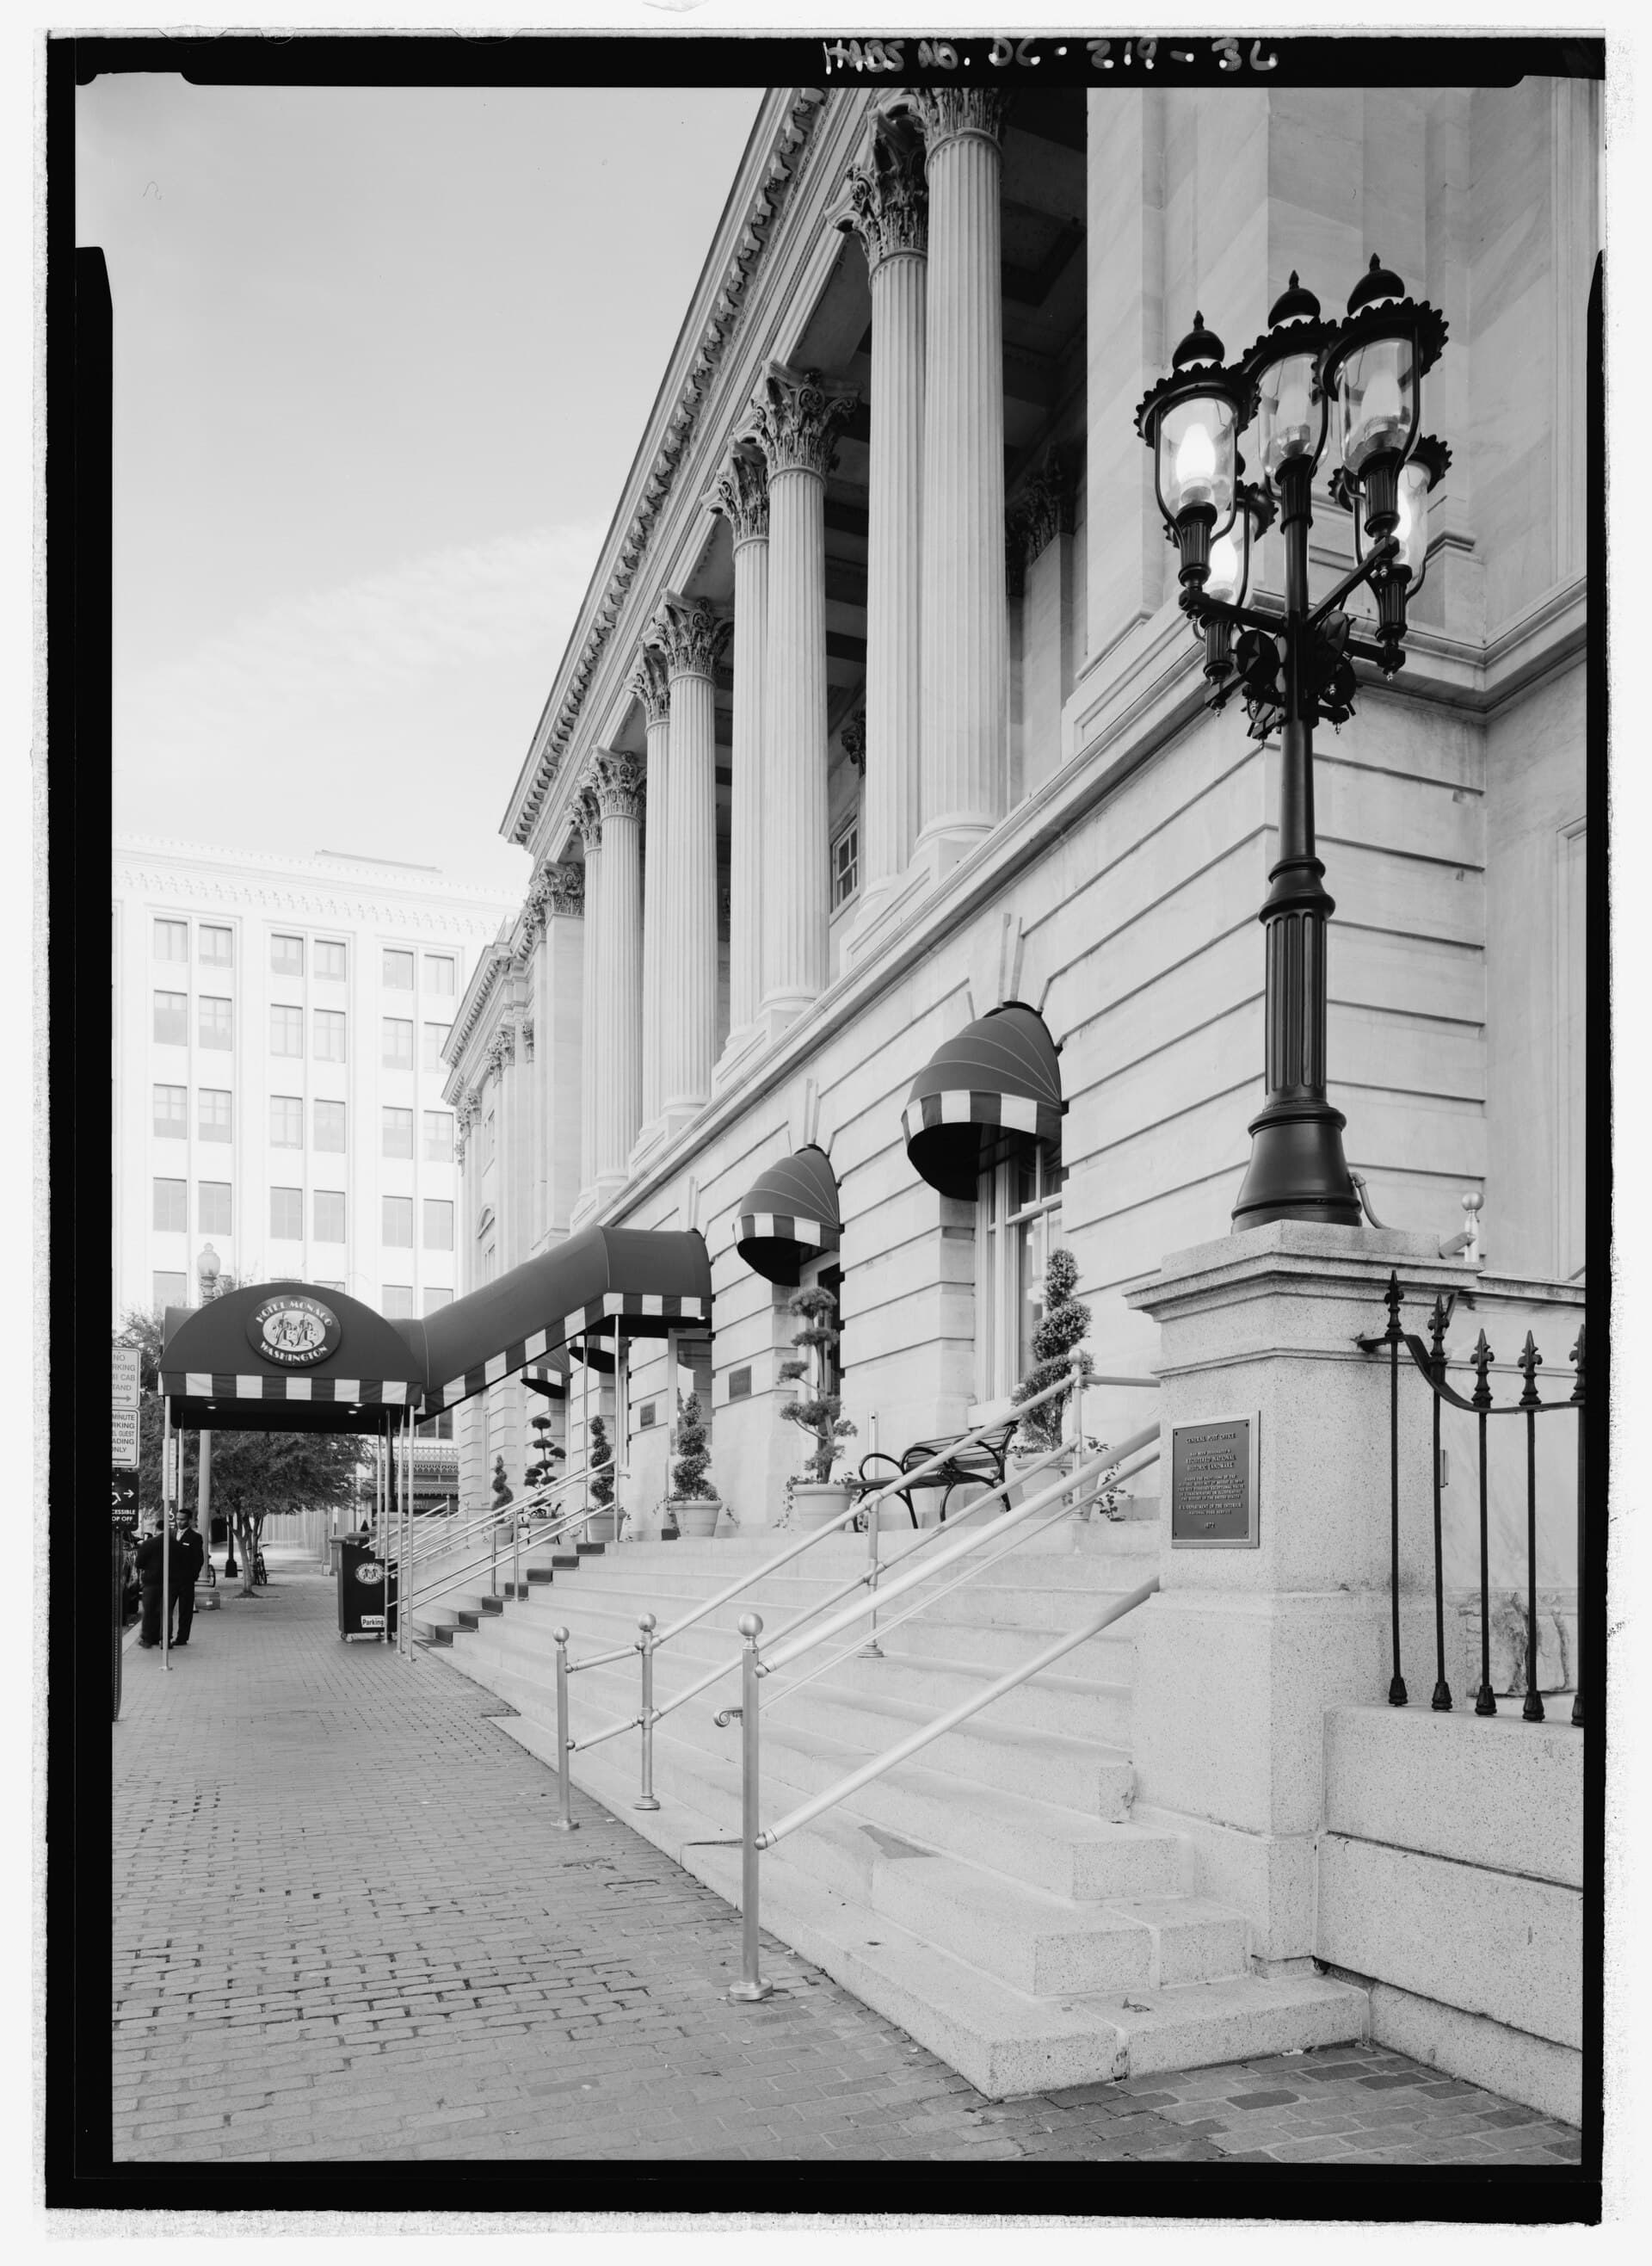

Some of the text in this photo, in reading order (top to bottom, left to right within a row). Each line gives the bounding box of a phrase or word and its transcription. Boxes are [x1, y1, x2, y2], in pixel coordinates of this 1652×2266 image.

[823, 39, 905, 75] HABS
[918, 39, 971, 70] NO.
[256, 1300, 332, 1326] HOTEL MONACO
[260, 1340, 329, 1362] WASHINGTON
[120, 1373, 136, 1381] CAB
[362, 1618, 384, 1627] Parking
